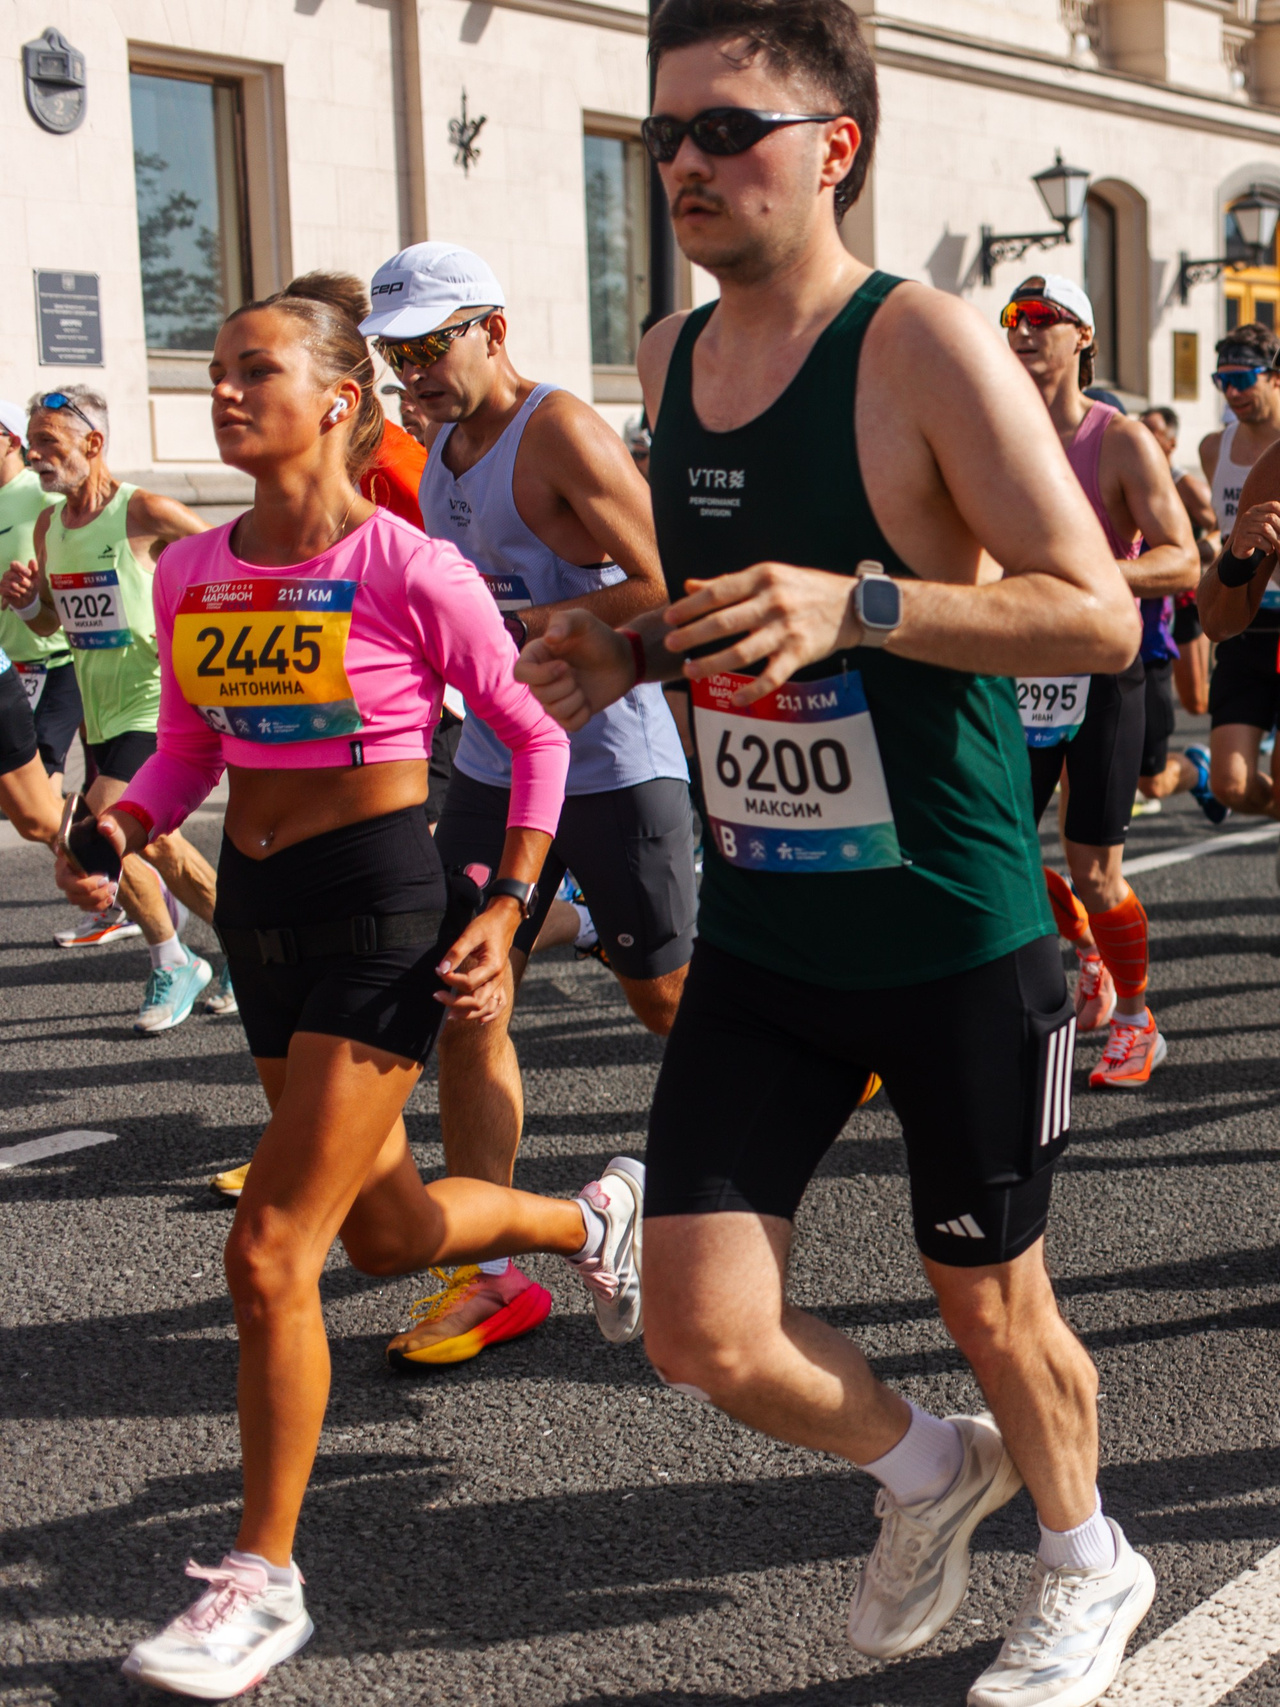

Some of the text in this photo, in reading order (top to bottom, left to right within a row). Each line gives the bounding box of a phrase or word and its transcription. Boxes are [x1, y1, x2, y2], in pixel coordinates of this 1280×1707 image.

[54, 100, 64, 115] 2
[371, 281, 404, 296] cep
[688, 467, 728, 488] VTR
[205, 583, 253, 594] ПОЛУ 2026
[278, 588, 303, 602] 21,1
[201, 591, 253, 603] МАРАФОН
[60, 593, 114, 619] 1202
[74, 620, 103, 629] МИХАИЛ
[196, 625, 323, 677] 2445
[219, 681, 305, 697] АНТОНИНА
[1017, 683, 1077, 711] 2995
[776, 693, 803, 711] 21,1
[1032, 713, 1053, 722] ИВАН
[716, 730, 852, 795] 6200
[745, 797, 822, 818] МАКСИМ
